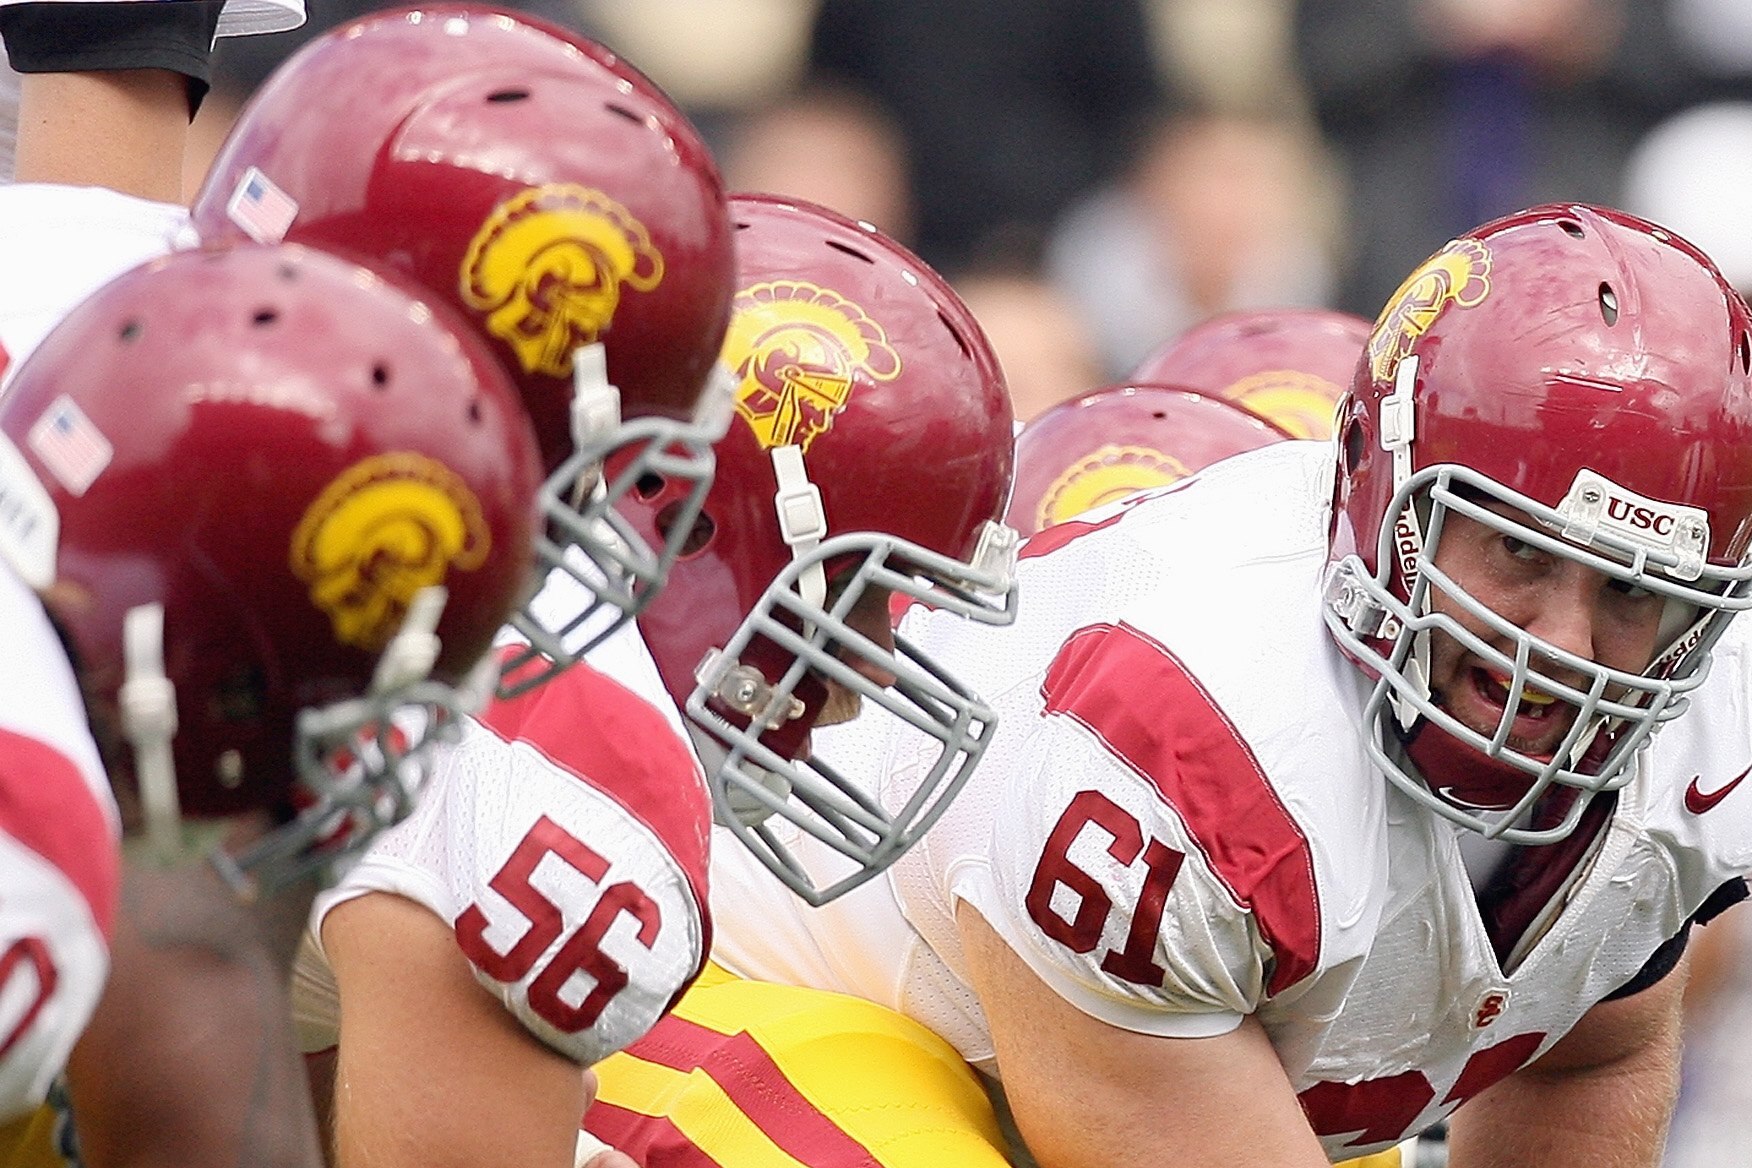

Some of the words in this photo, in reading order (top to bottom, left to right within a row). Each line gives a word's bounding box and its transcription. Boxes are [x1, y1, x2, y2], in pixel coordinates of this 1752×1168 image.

[1607, 496, 1675, 536] USC
[454, 813, 663, 1035] 56
[1025, 790, 1186, 988] 61
